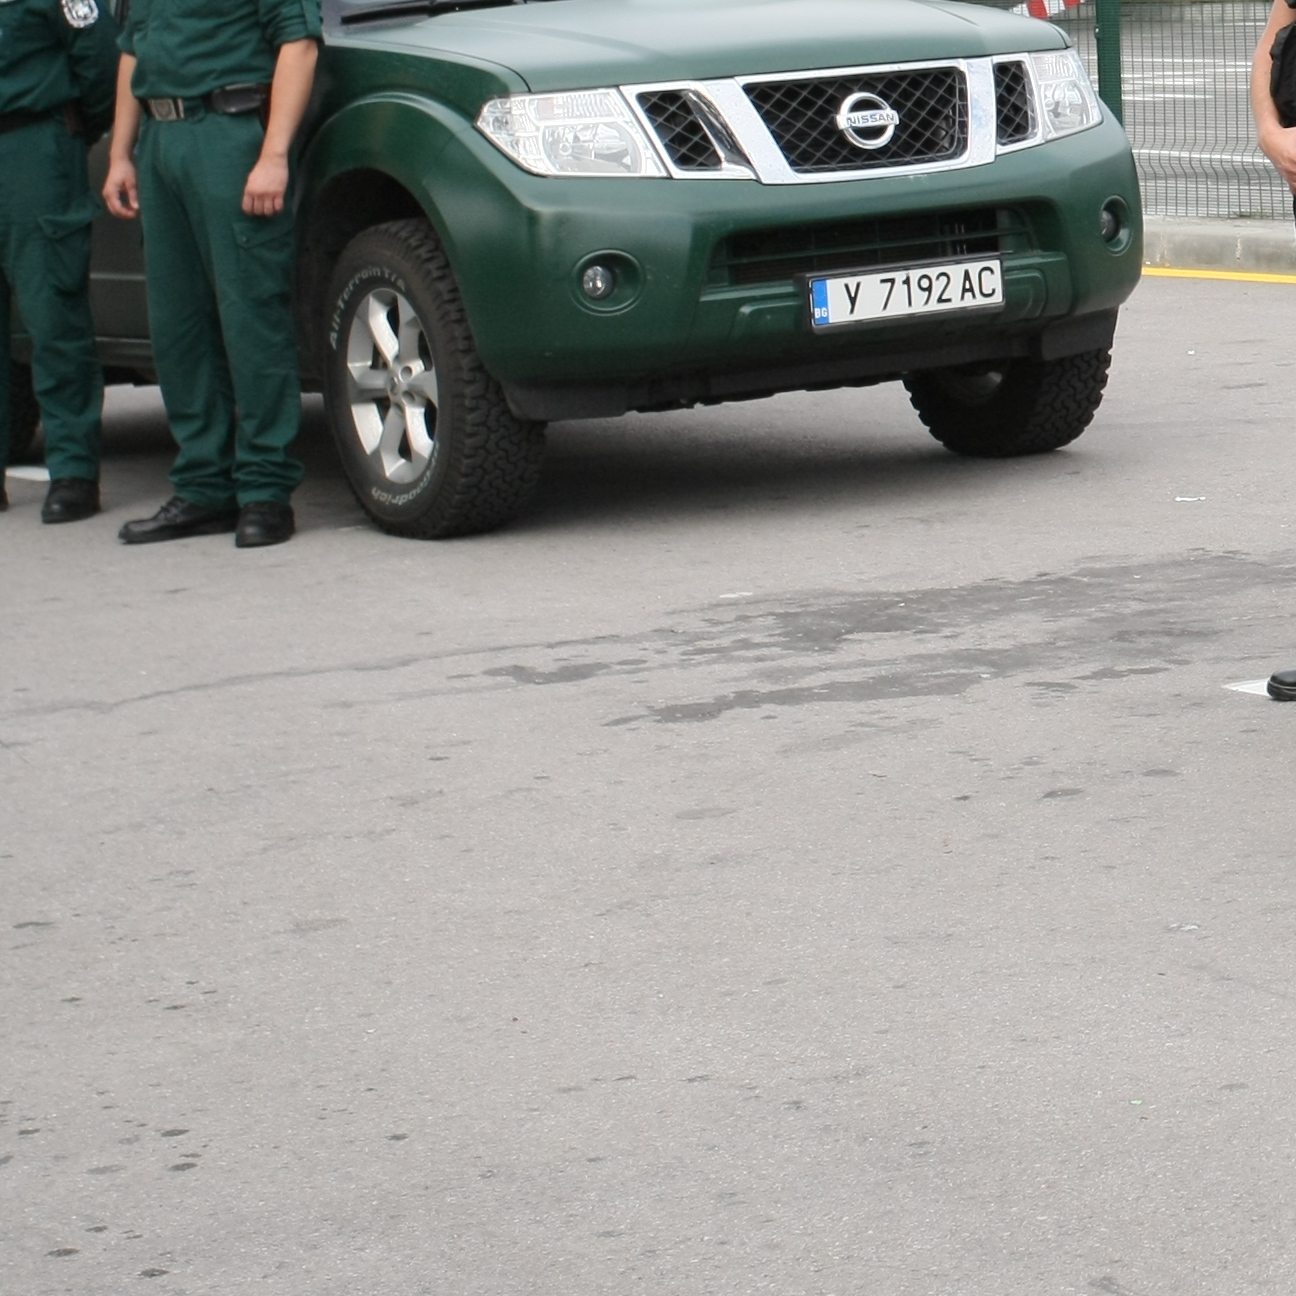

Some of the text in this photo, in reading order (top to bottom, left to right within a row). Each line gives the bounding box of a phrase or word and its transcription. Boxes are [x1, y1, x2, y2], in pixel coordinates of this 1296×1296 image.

[846, 112, 895, 126] NISSAN
[879, 272, 953, 312] 7192
[960, 266, 997, 302] AC
[814, 306, 828, 319] BG
